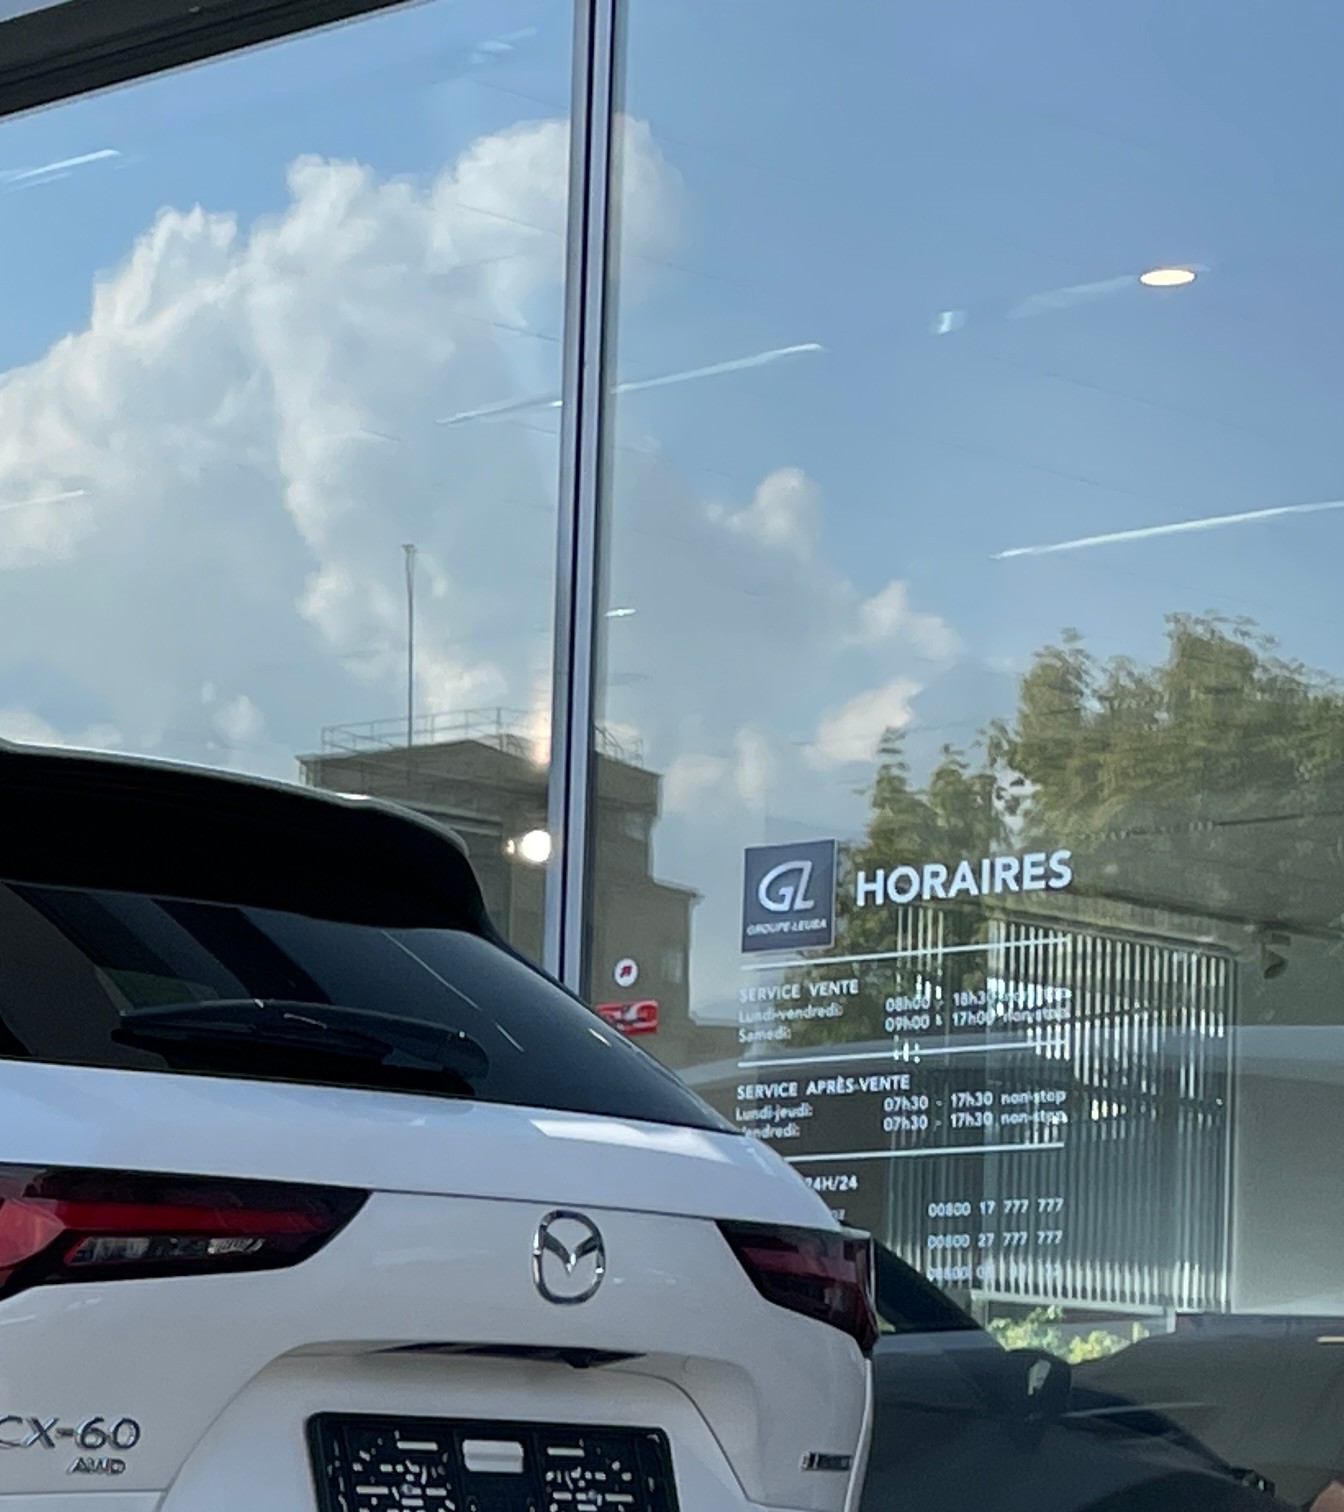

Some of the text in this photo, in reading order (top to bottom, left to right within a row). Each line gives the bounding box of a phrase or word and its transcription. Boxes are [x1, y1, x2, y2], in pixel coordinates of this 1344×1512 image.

[856, 850, 1072, 907] HORAIRES
[738, 979, 860, 1002] SERVICE VENTE
[885, 1014, 930, 1032] 09h00
[737, 1074, 910, 1100] SERVICE APRÈS-VENTE
[884, 1095, 929, 1112] 07h30
[951, 1091, 993, 1108] 17h30
[1001, 1090, 1067, 1107] non-stop
[884, 1114, 928, 1132] 07h30
[951, 1111, 993, 1128] 17h30
[979, 1199, 996, 1215] 17
[1003, 1198, 1029, 1214] 777
[1037, 1197, 1064, 1213] 777
[978, 1231, 995, 1248] 27
[1002, 1231, 1028, 1247] 777
[1037, 1229, 1063, 1245] 777
[66, 1456, 126, 1475] AWD
